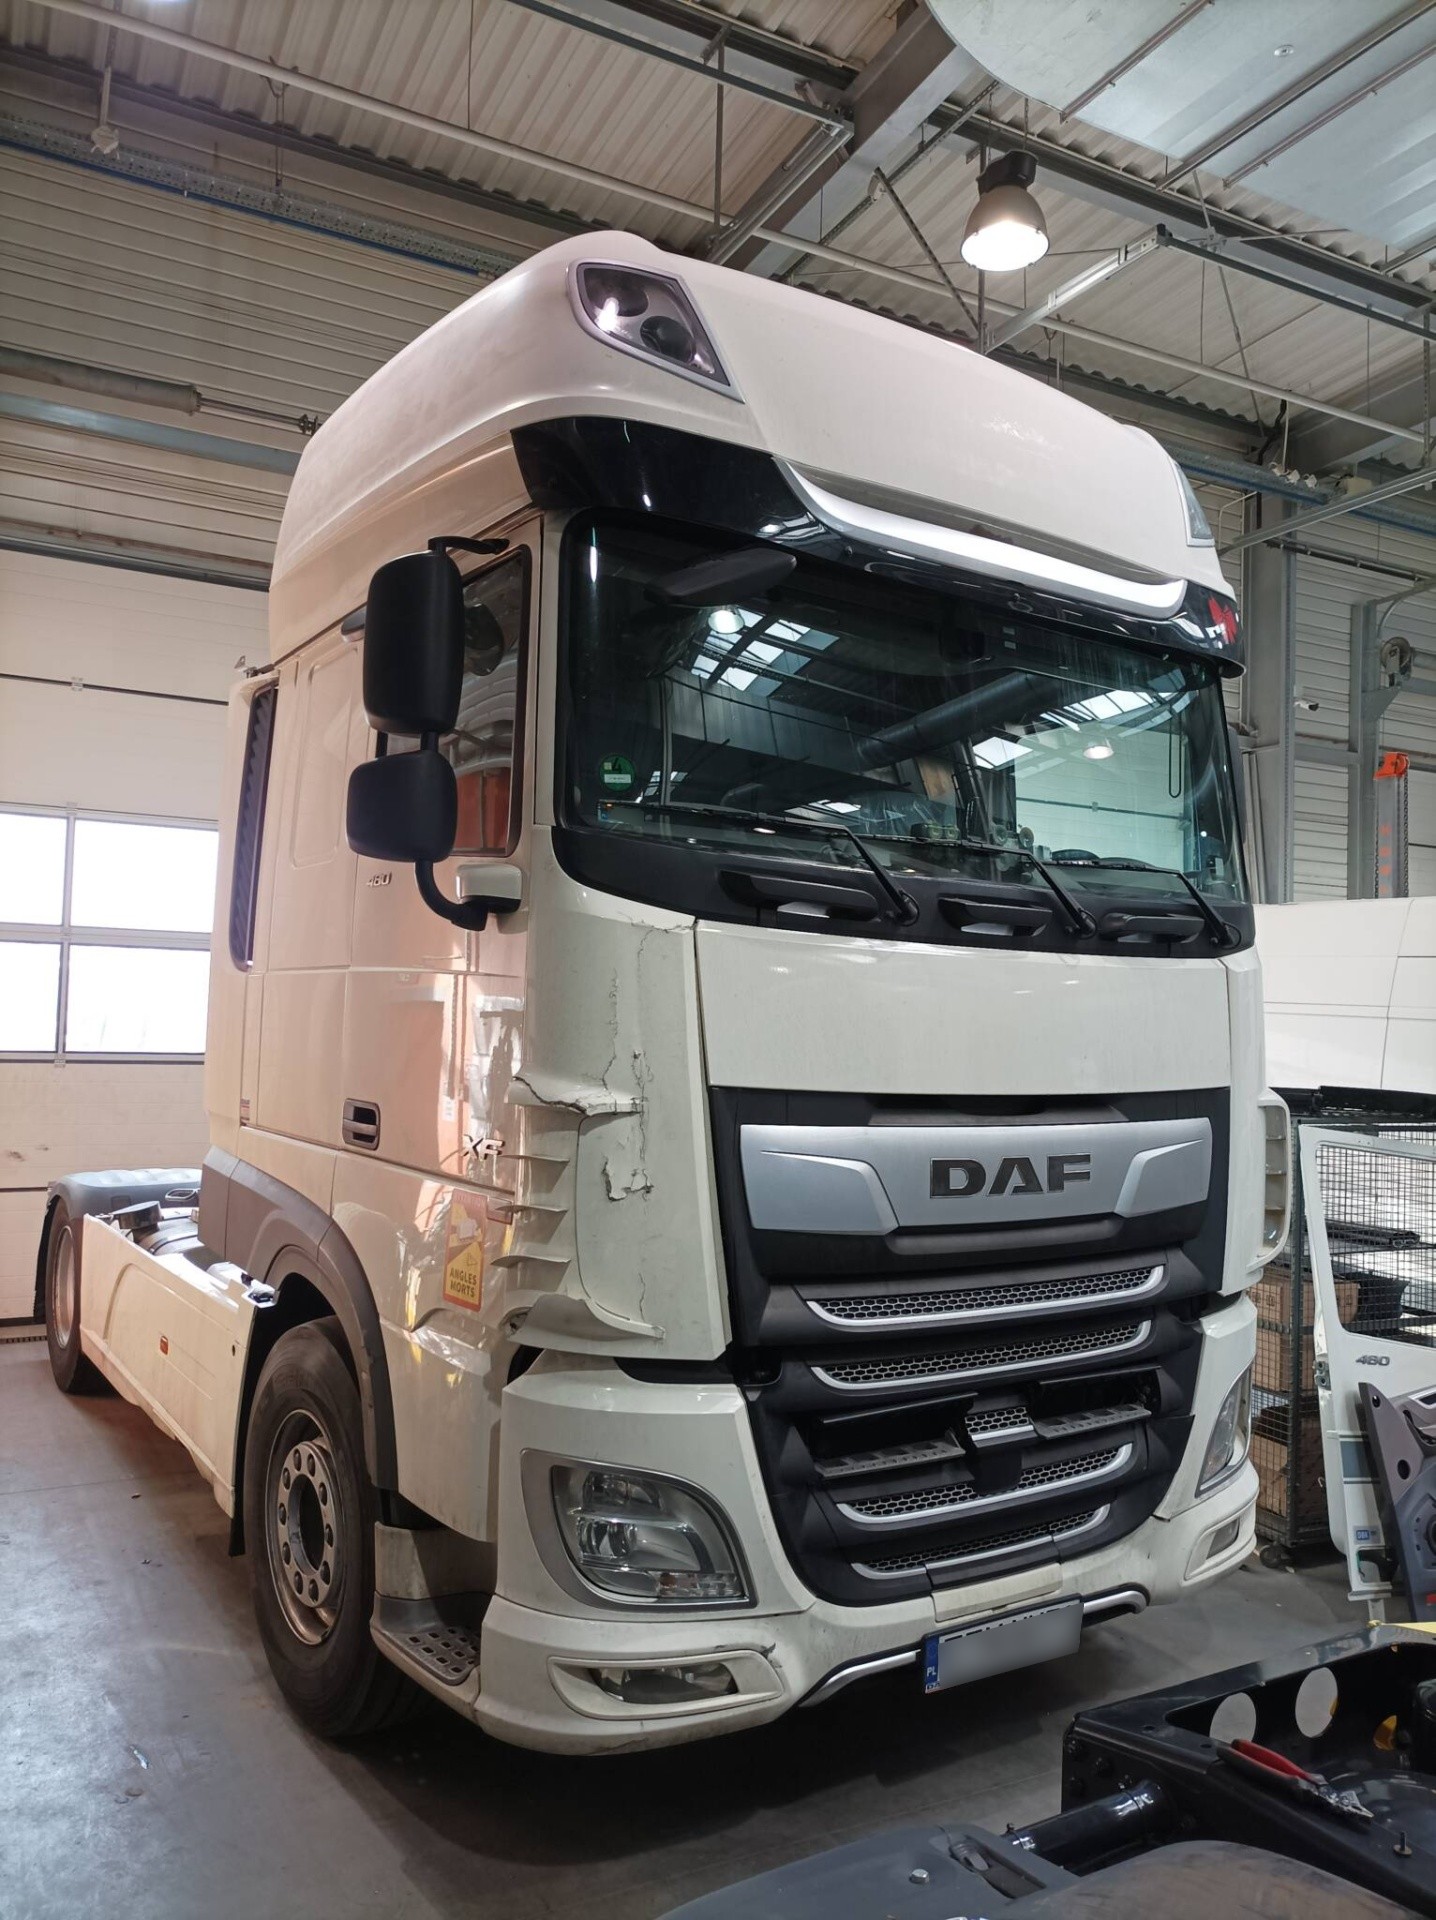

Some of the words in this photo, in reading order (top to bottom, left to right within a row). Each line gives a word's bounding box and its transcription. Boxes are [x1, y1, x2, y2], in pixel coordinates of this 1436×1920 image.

[463, 1134, 506, 1160] XF
[929, 1152, 1091, 1199] DAF
[449, 1267, 477, 1286] ANGLES
[450, 1280, 475, 1298] MORTS
[926, 1666, 937, 1677] PL
